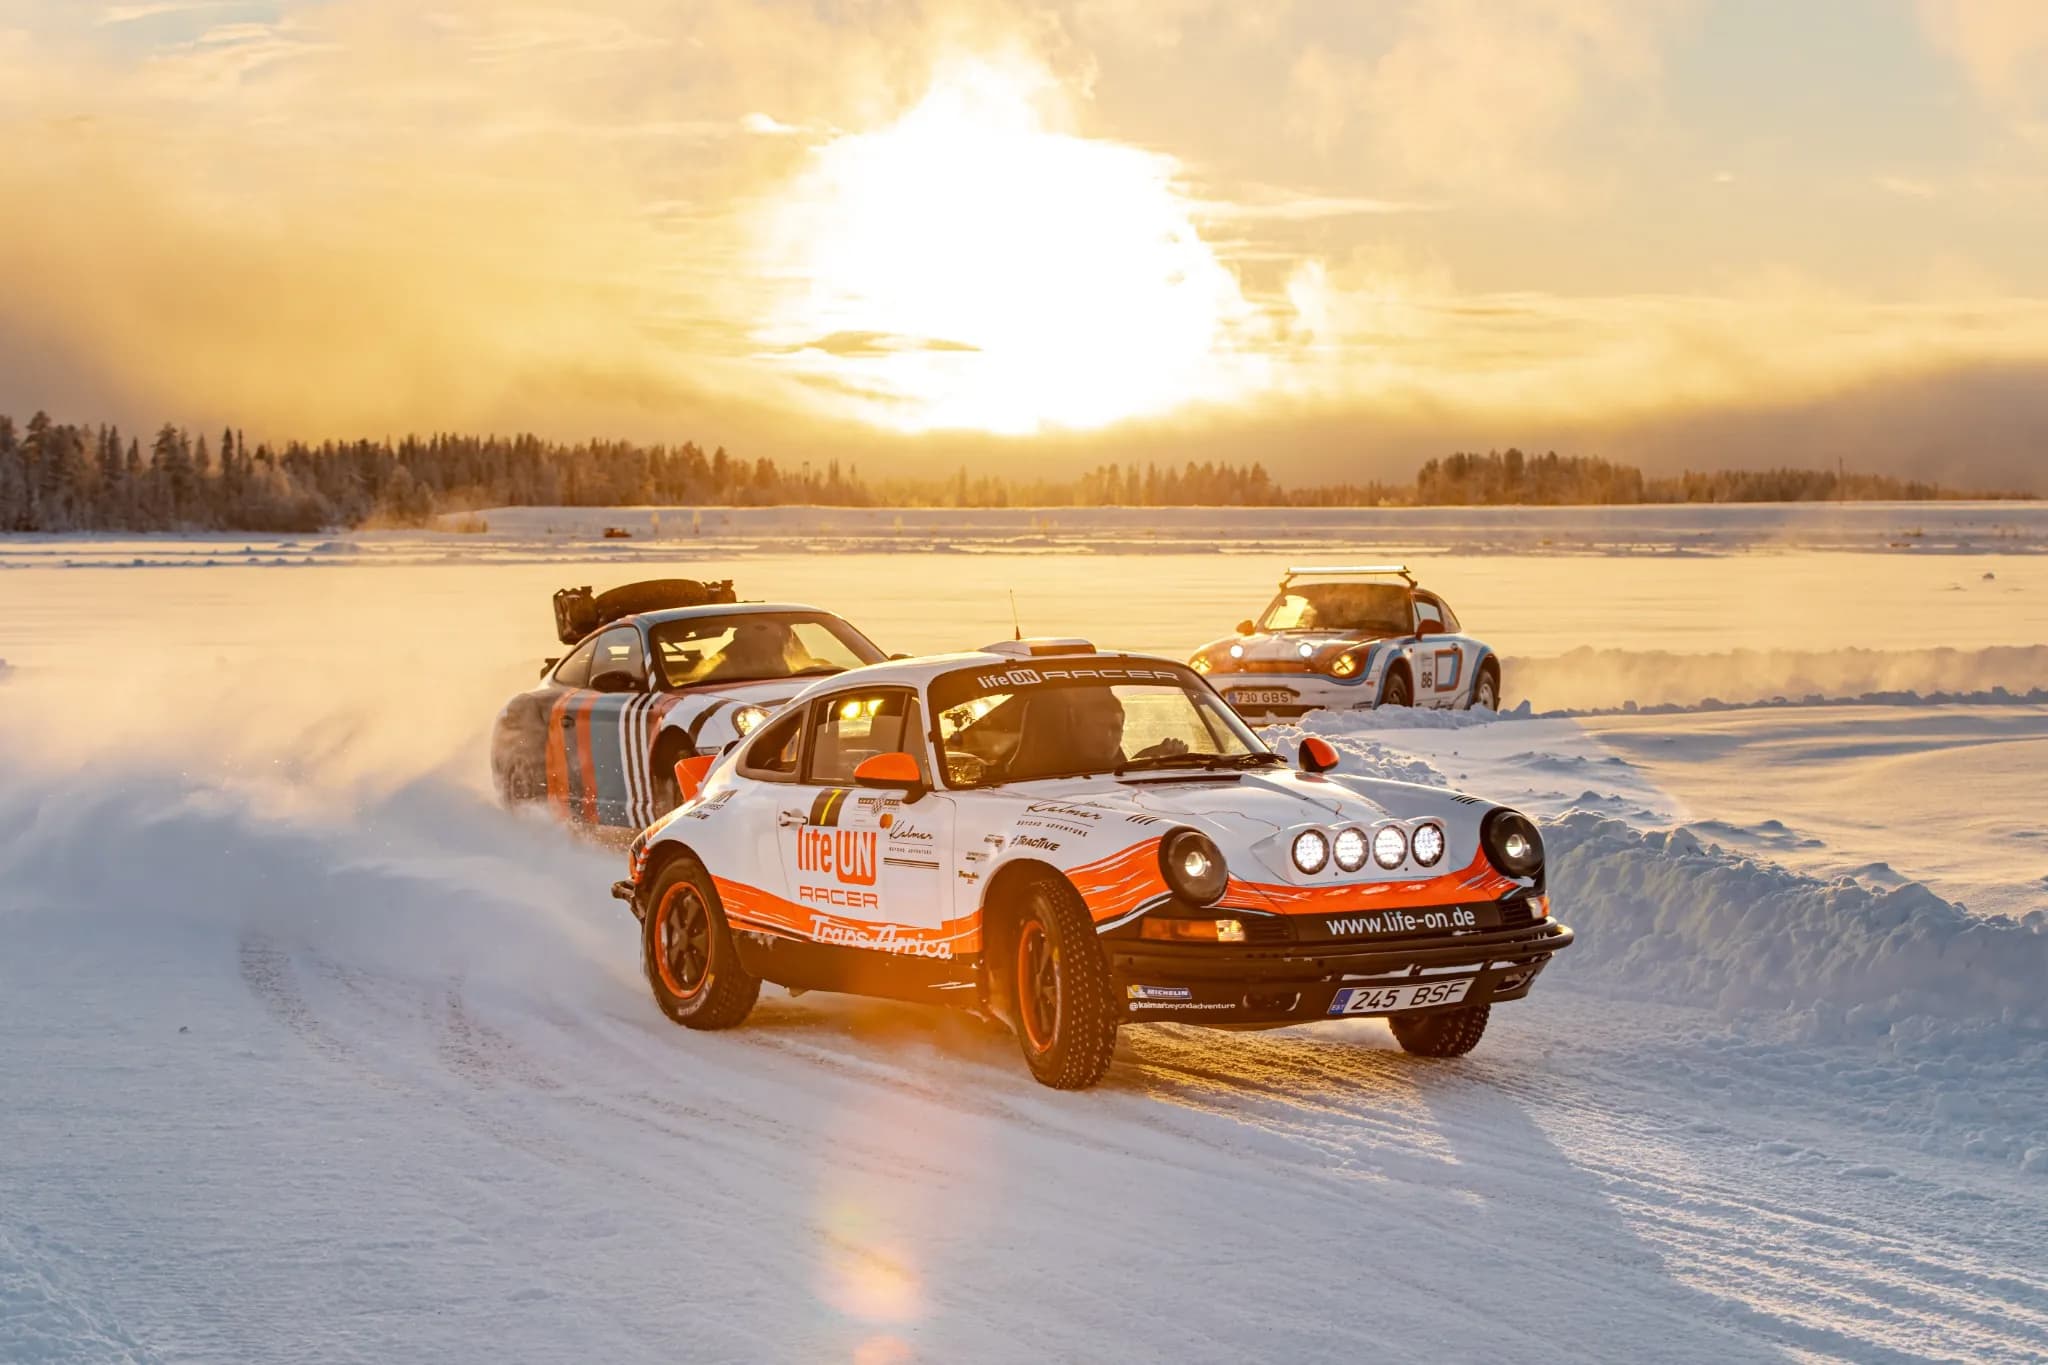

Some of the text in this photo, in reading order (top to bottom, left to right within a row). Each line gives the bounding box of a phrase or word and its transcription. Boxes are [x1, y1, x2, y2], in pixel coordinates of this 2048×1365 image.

[977, 674, 1009, 689] life
[1042, 669, 1179, 682] RACER
[1421, 672, 1433, 688] 86
[1238, 692, 1289, 703] 730 GBS
[800, 886, 879, 909] RACER
[1326, 906, 1476, 936] www.life-on.de
[1147, 988, 1189, 996] MICHELIN
[1350, 990, 1400, 1010] 245
[1410, 981, 1467, 1006] BSF
[1129, 1001, 1236, 1012] @kalmarbeyondadventure
